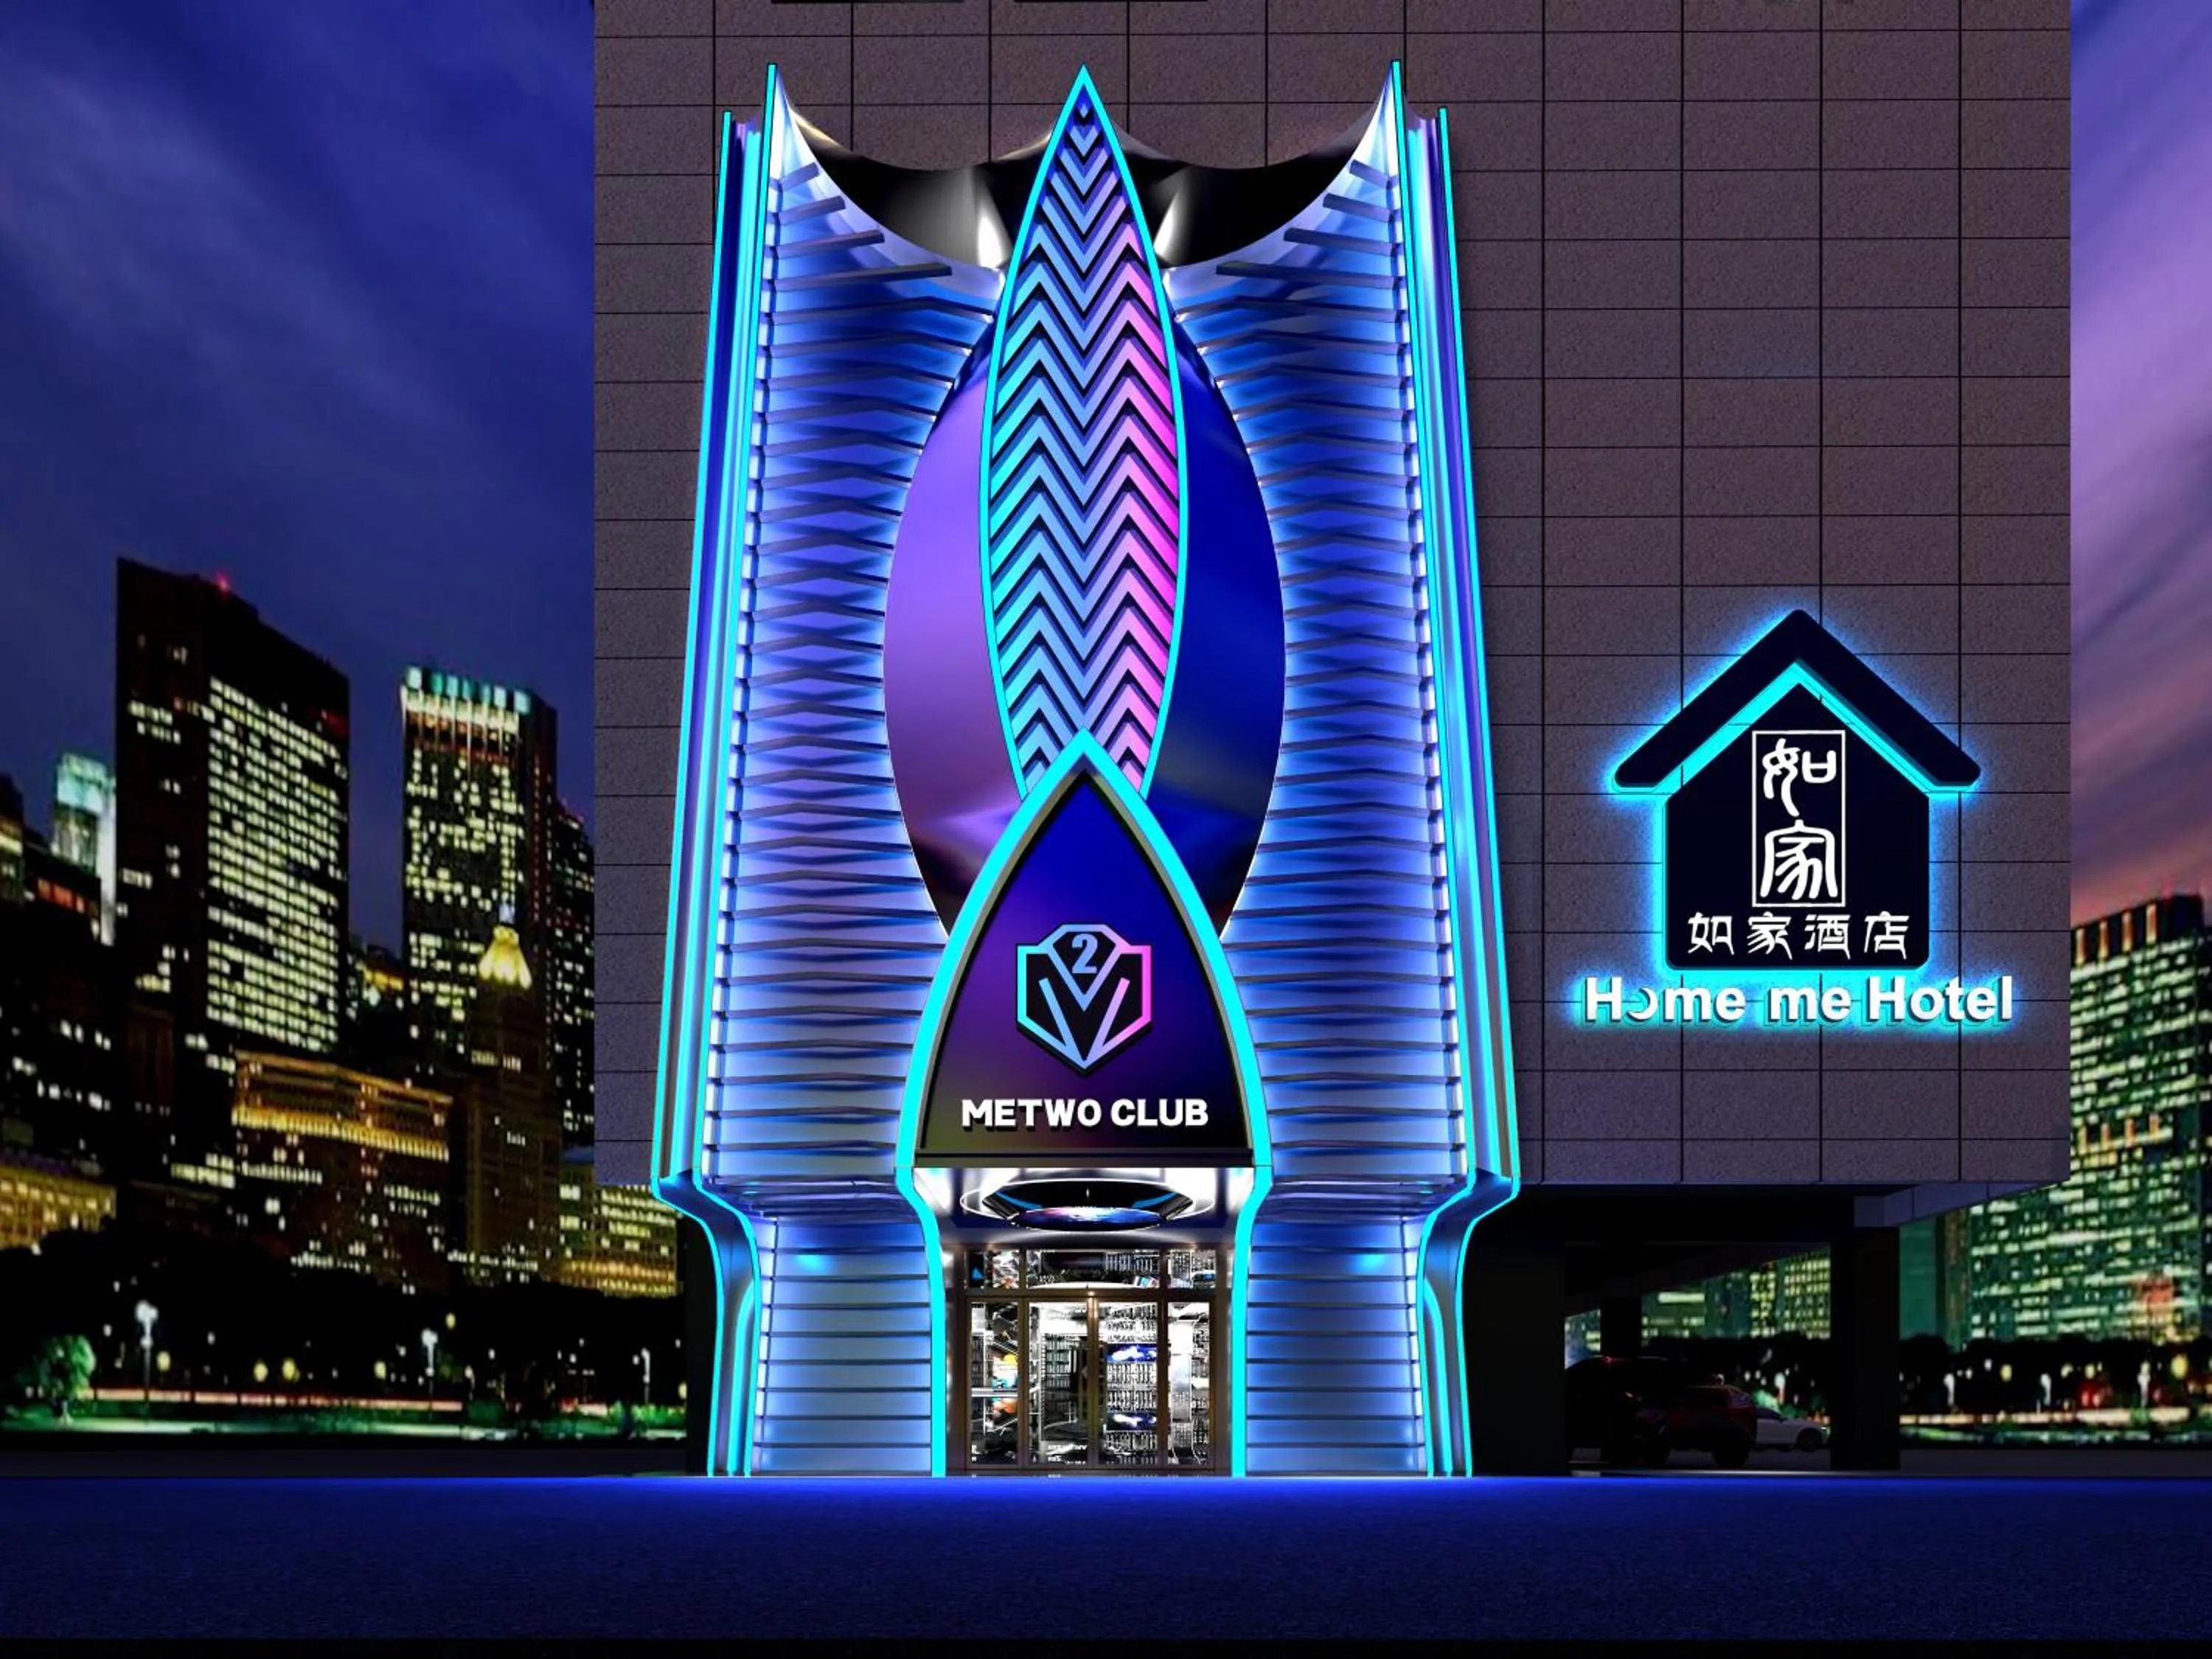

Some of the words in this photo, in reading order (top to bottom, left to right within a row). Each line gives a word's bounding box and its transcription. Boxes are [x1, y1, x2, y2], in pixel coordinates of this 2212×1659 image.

[1687, 911, 1910, 960] 如家酒店
[1770, 987, 1852, 1021] me
[1870, 976, 2013, 1022] Hotel
[961, 1099, 1102, 1127] METWO
[1110, 1099, 1209, 1127] CLUB
